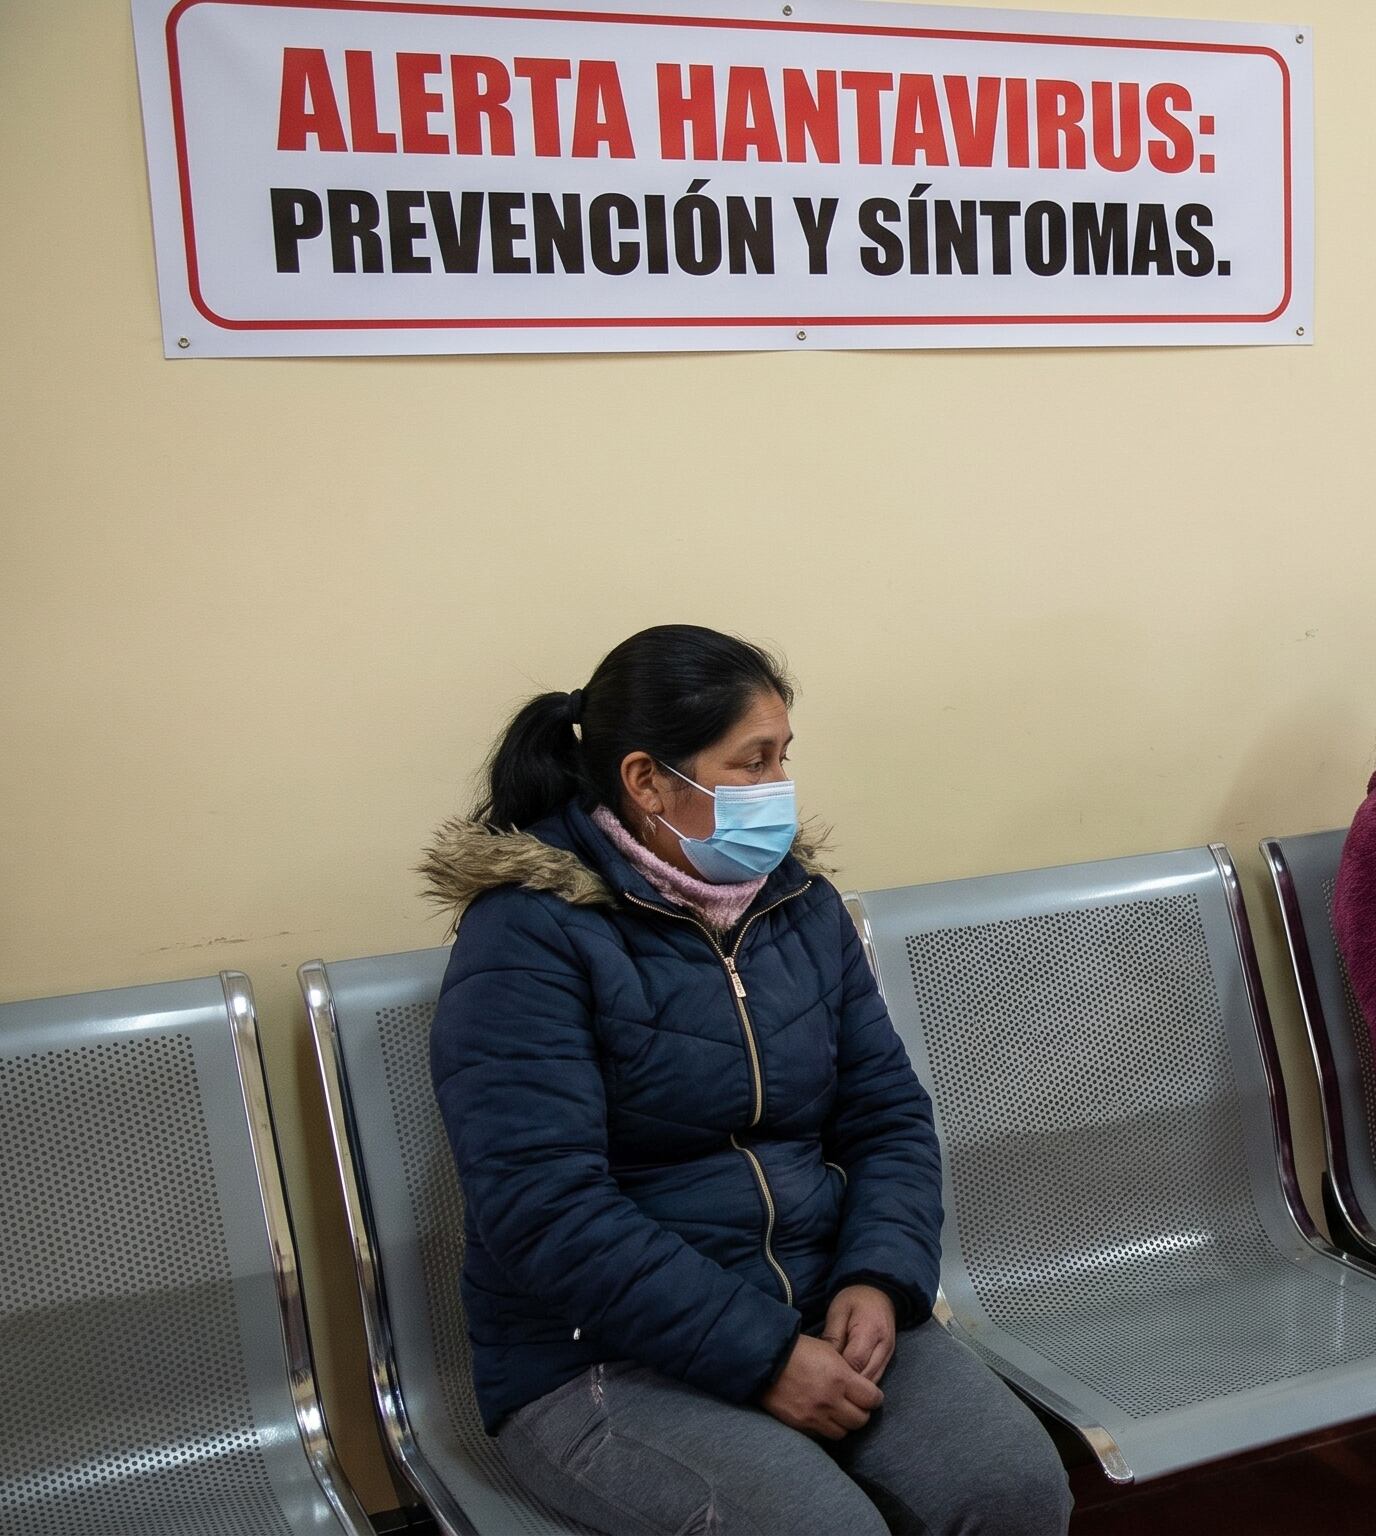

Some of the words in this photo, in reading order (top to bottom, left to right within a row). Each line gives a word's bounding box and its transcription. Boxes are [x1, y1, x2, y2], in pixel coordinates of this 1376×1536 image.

[278, 48, 635, 160] ALERTA
[656, 63, 1215, 174] HANTAVIRUS:
[271, 178, 775, 276] PREVENCIÓN
[792, 197, 839, 275] Y
[858, 183, 1231, 277] SÍNTOMAS.
